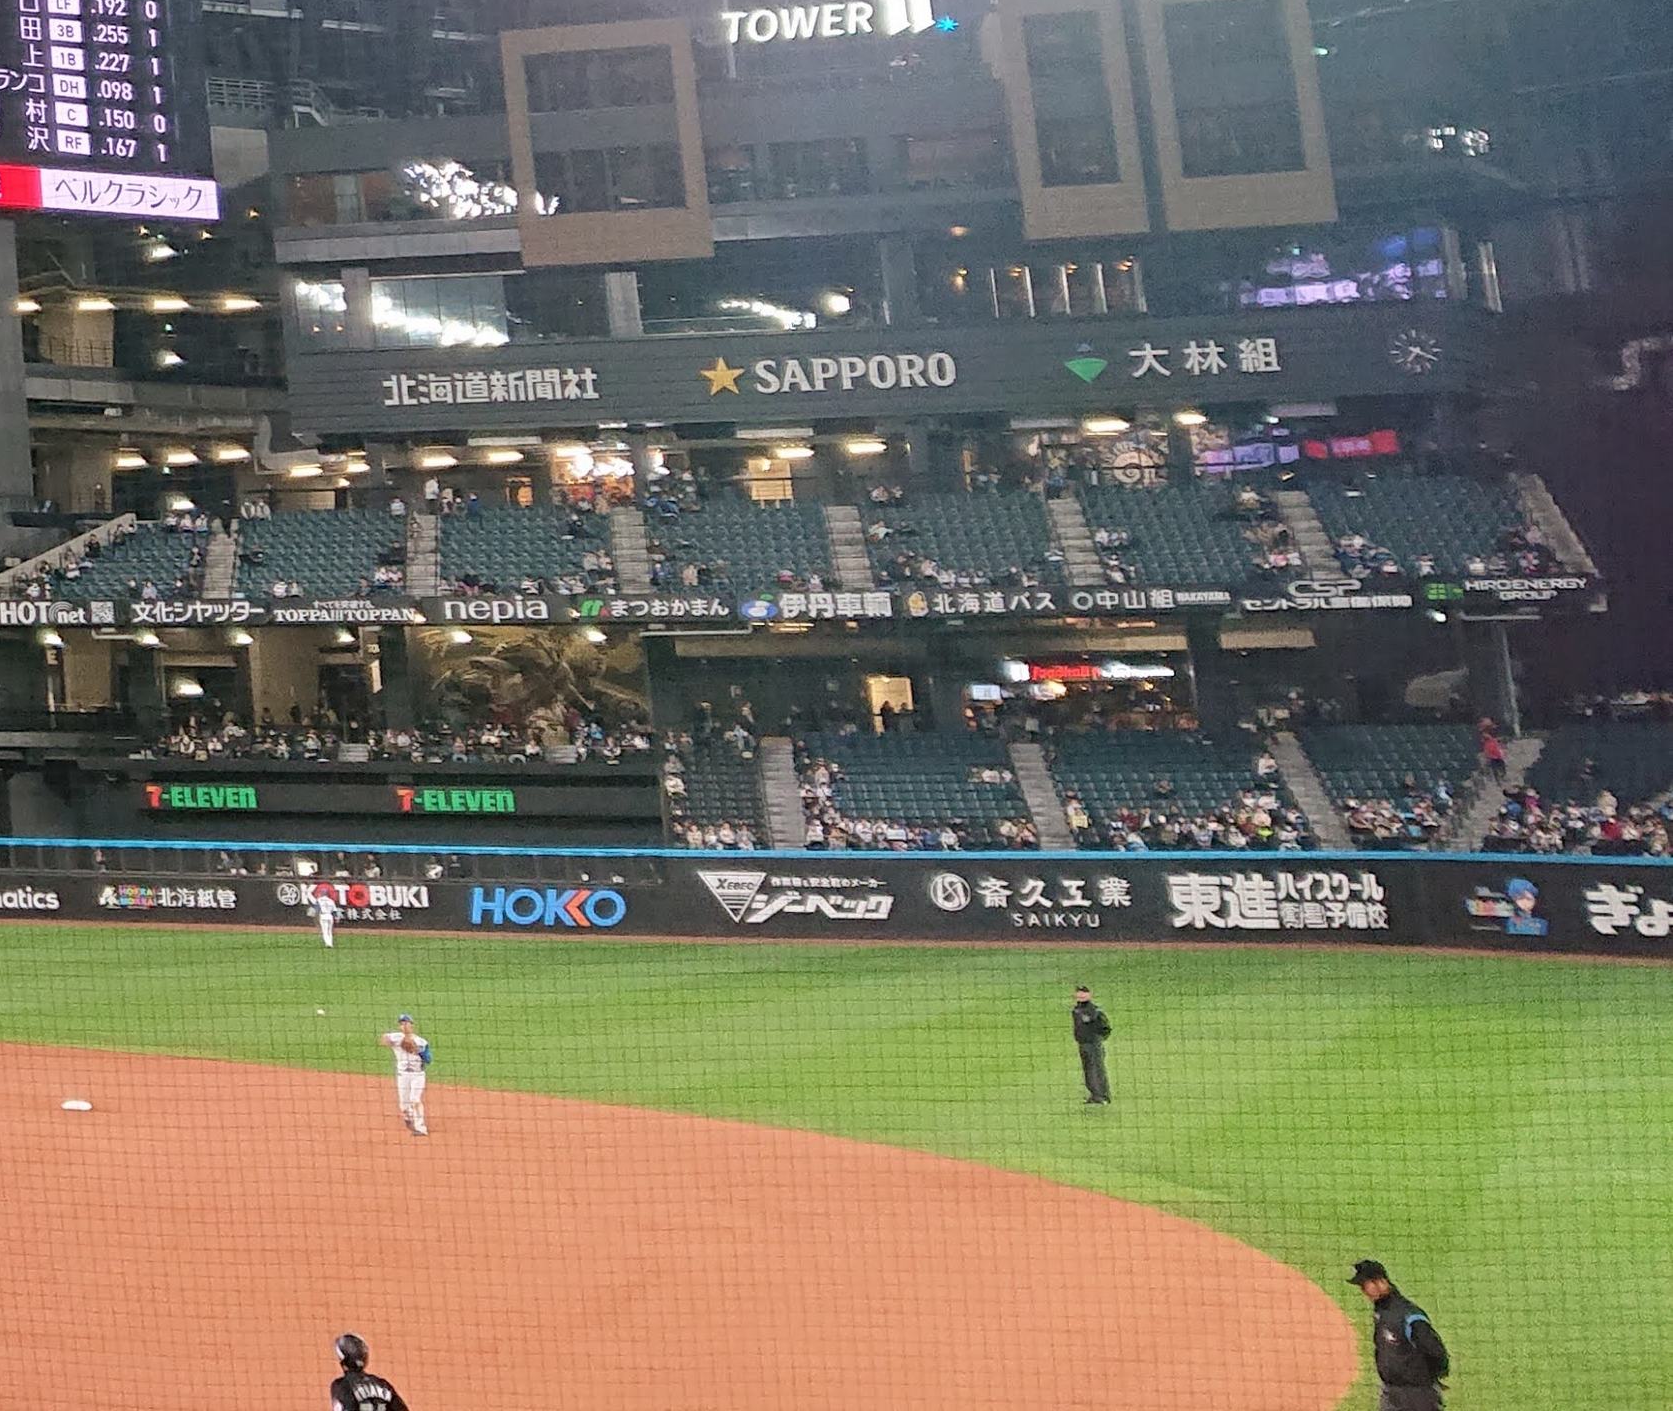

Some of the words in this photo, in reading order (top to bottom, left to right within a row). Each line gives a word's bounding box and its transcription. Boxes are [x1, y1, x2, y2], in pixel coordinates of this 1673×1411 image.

[721, 0, 873, 43] TOWER
[96, 82, 133, 102] .098
[101, 138, 136, 158] .167
[54, 177, 203, 212] ベルクラシック
[1128, 338, 1282, 378] 大林組
[754, 352, 956, 395] SAPPORO
[382, 367, 600, 407] 北海道新聞社
[933, 591, 1056, 613] 北海道バス
[1288, 580, 1361, 598] CSP
[1499, 589, 1557, 602] GROUP
[444, 597, 549, 623] nepia
[610, 597, 729, 617] まつおかまん
[471, 887, 627, 927] HOKKO
[1166, 872, 1280, 930] 東進
[1013, 913, 1100, 928] SAIKYU
